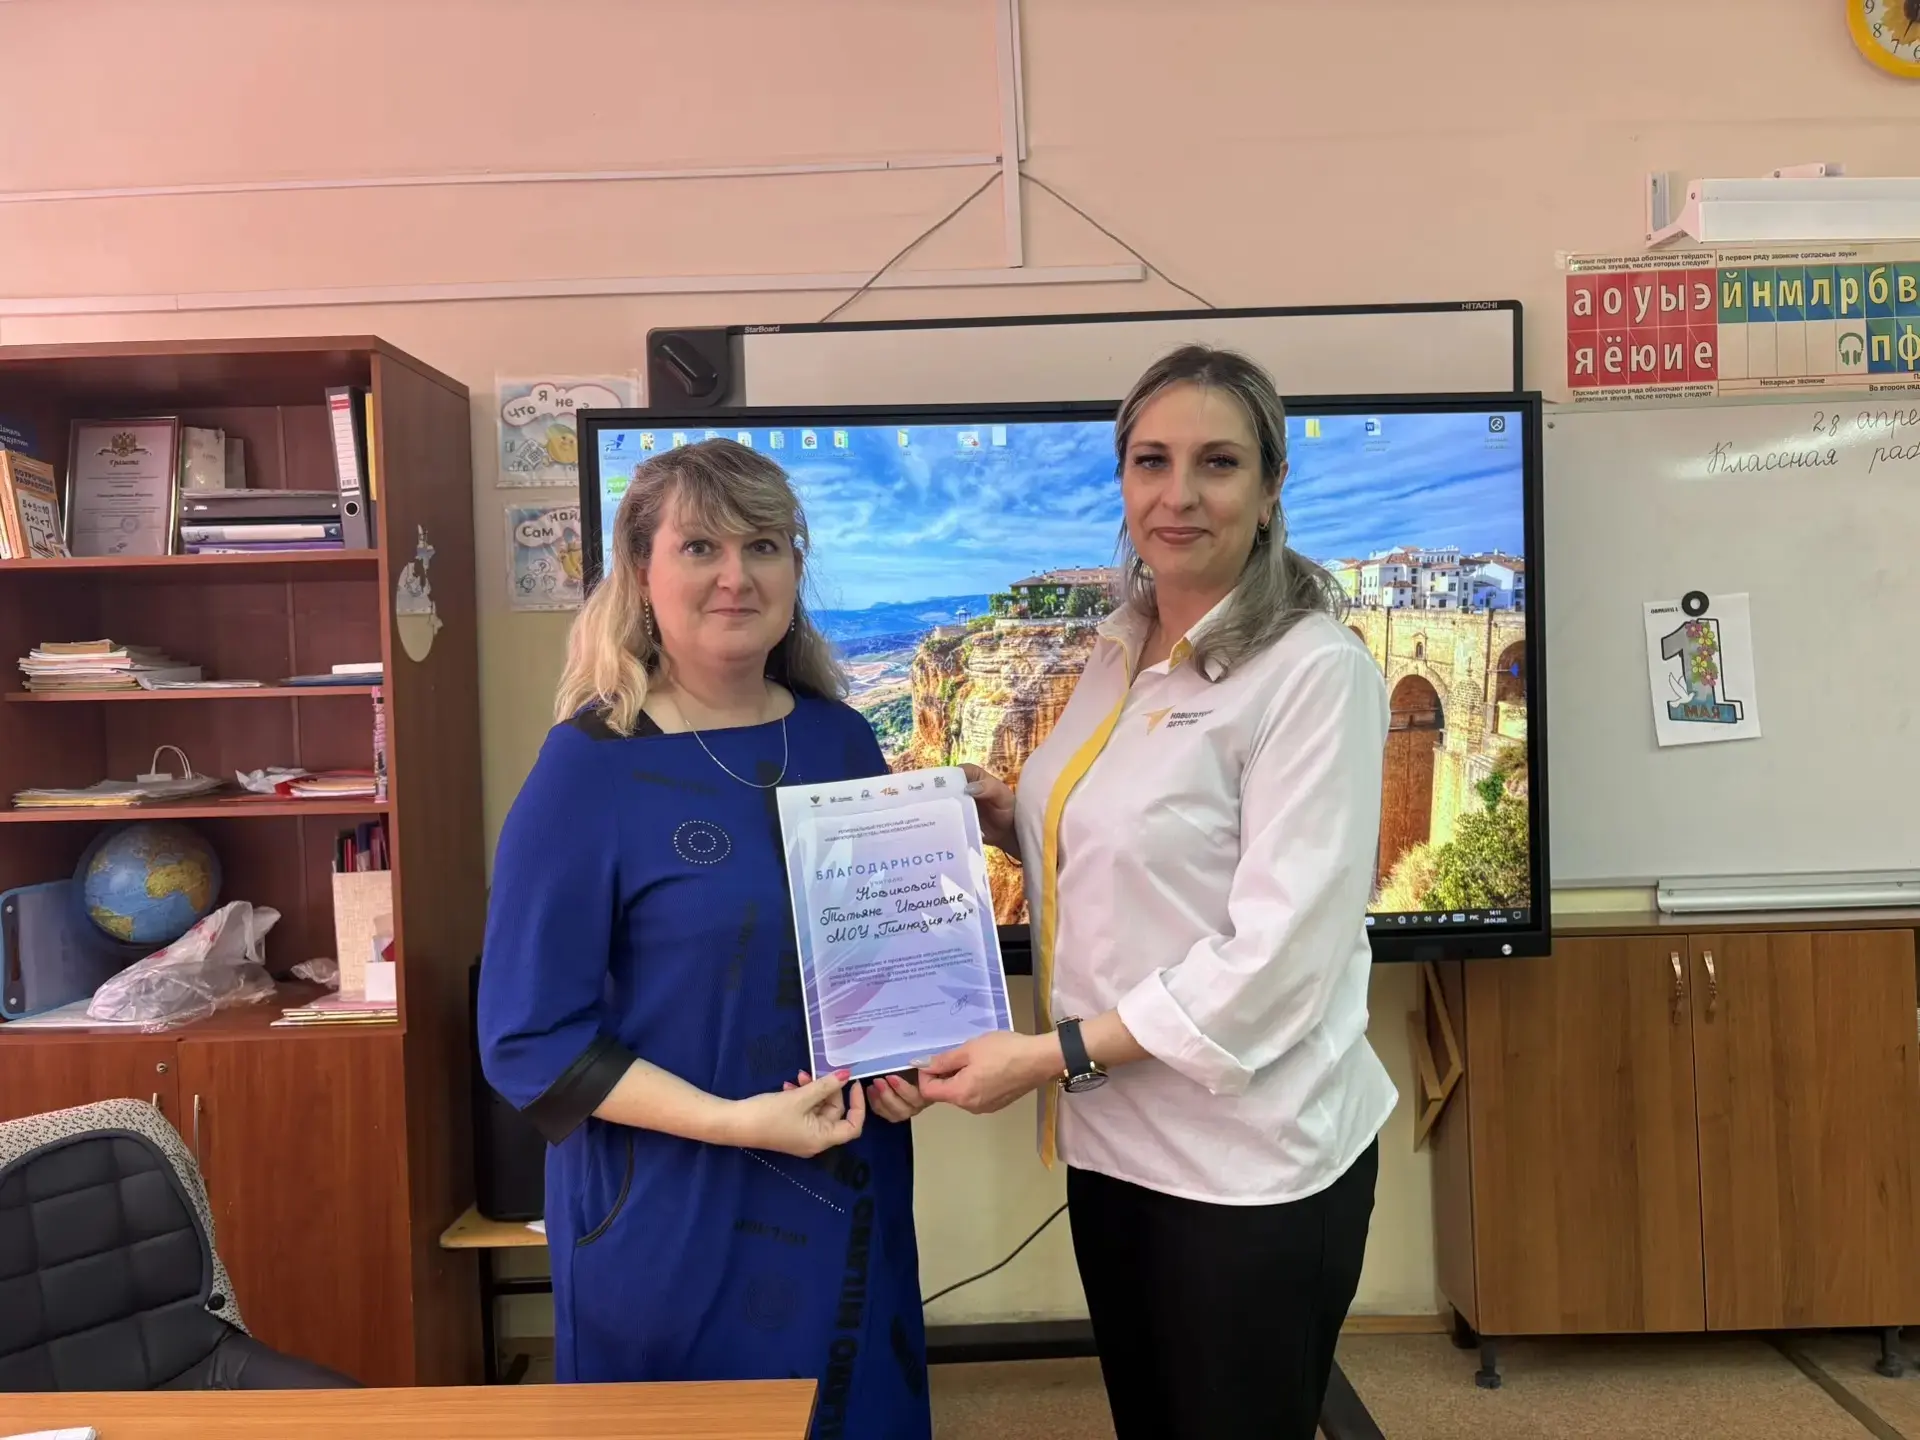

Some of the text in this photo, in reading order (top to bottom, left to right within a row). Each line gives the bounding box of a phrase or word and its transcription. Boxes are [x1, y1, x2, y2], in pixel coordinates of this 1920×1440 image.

[1864, 0, 1875, 14] 9
[1873, 22, 1882, 39] 8
[1891, 38, 1900, 54] 7
[1568, 253, 1714, 266] Гласные первого ряда обозначают твёрдость
[1753, 254, 1770, 262] ряду
[1838, 251, 1857, 259] звуки
[1608, 263, 1631, 271] звуков,
[1653, 261, 1681, 269] которых
[1682, 259, 1710, 268] следуют
[1572, 266, 1917, 324] а о у ы э й н м л р б в
[1461, 301, 1498, 310] HITACHI
[744, 325, 780, 334] StarBoard
[1574, 324, 1920, 375] я ё ю и е п ф
[1760, 379, 1796, 387] Непарные
[1869, 384, 1878, 392] Во
[1572, 389, 1600, 397] Гласные
[1601, 389, 1626, 397] второго
[1628, 388, 1643, 396] ряда
[1655, 392, 1682, 400] которых
[1683, 391, 1712, 399] следуют
[508, 405, 537, 420] Что
[538, 390, 548, 401] Я
[555, 396, 574, 408] не
[1812, 407, 1920, 439] 28 апре
[1707, 441, 1839, 474] Классная
[522, 525, 554, 539] Сам
[1684, 705, 1720, 720] МАЯ
[816, 850, 955, 881] БЛАГОДАРНОСТЬ
[856, 875, 937, 902] Новиковой
[819, 893, 964, 926] Татьяне Ивановне
[826, 925, 870, 944] МОУ
